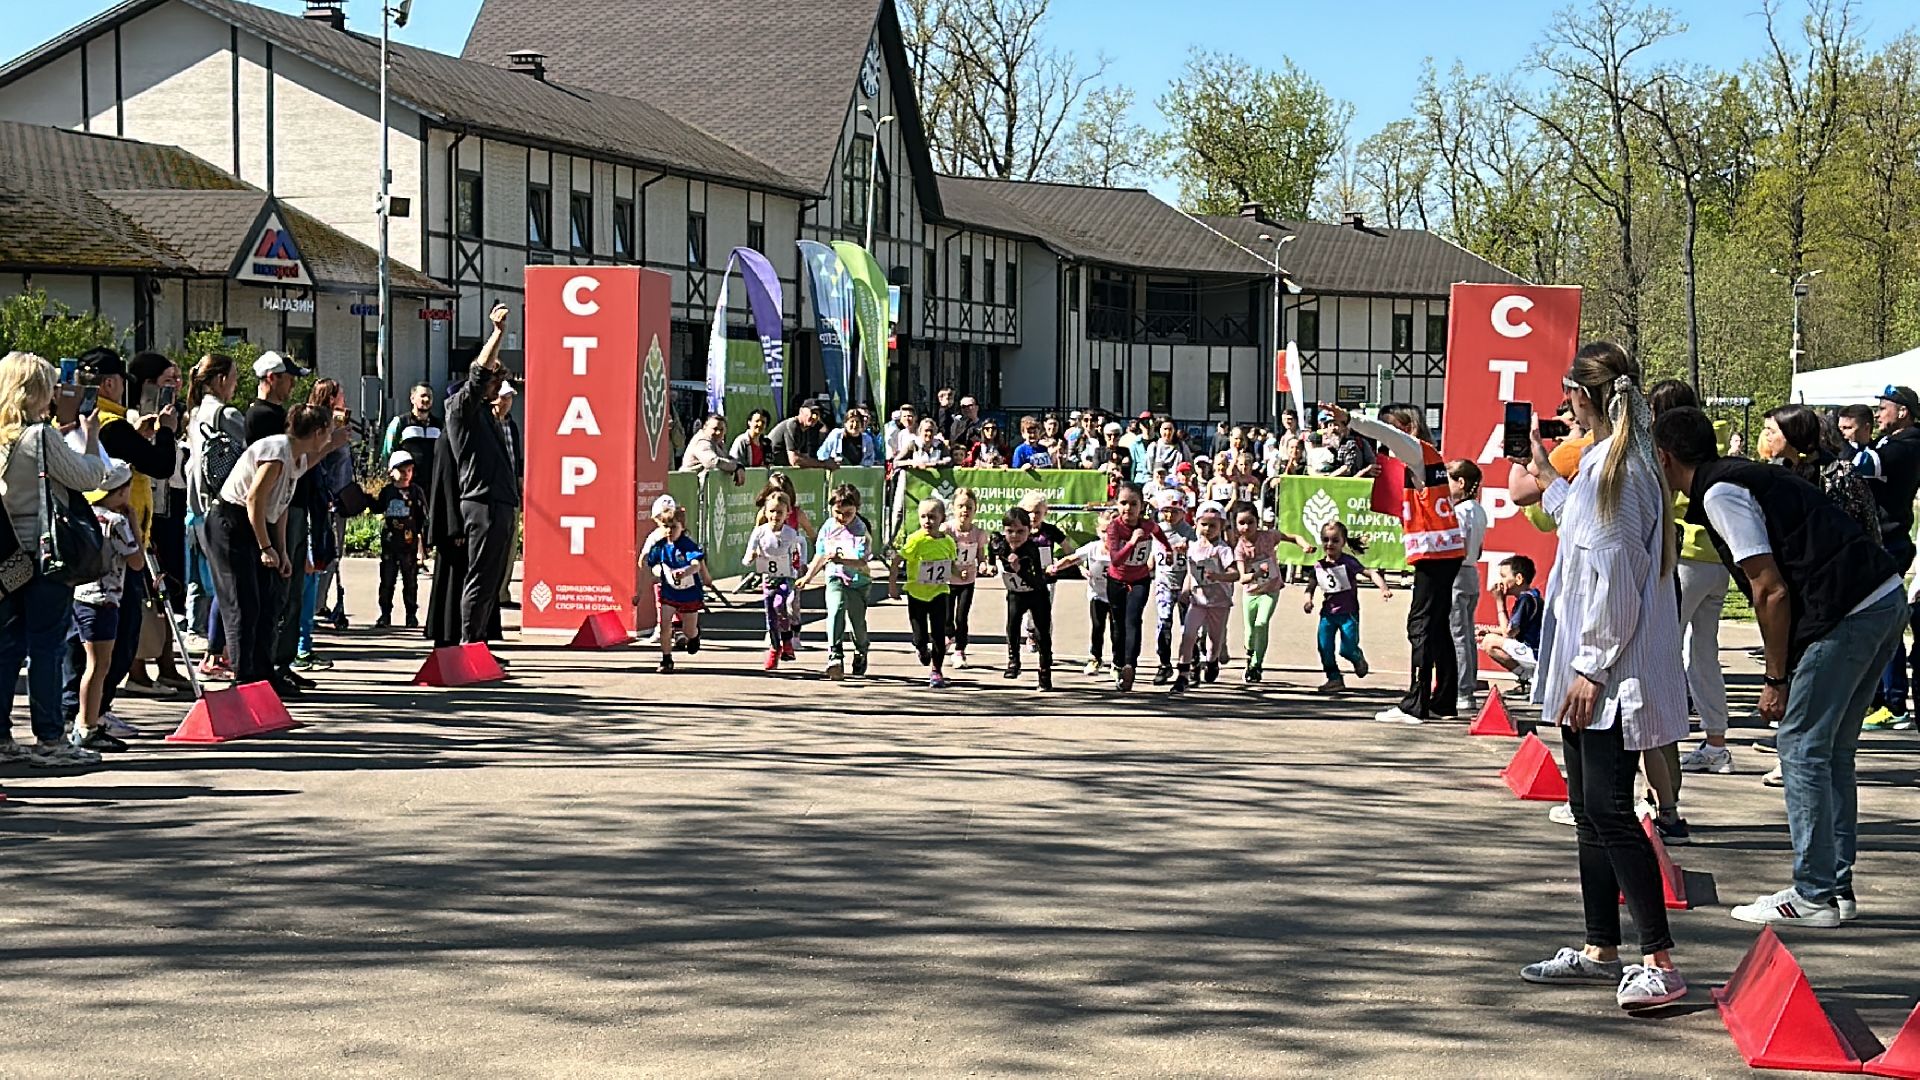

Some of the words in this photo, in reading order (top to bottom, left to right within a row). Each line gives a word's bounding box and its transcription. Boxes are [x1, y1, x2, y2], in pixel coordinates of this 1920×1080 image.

[263, 297, 314, 312] МАГАЗИН
[556, 276, 601, 554] СТАРТ
[971, 486, 1065, 500] ОДИНЦОКИЙ
[1346, 514, 1381, 526] ПАРК
[768, 560, 777, 573] 8
[926, 565, 945, 581] 12
[1327, 573, 1336, 589] 3
[555, 585, 612, 593] ОДИНЦОВСКИЙ
[555, 594, 575, 602] ПАРК
[555, 602, 584, 610] СПОРТА
[591, 603, 623, 611] ОТДЫХА
